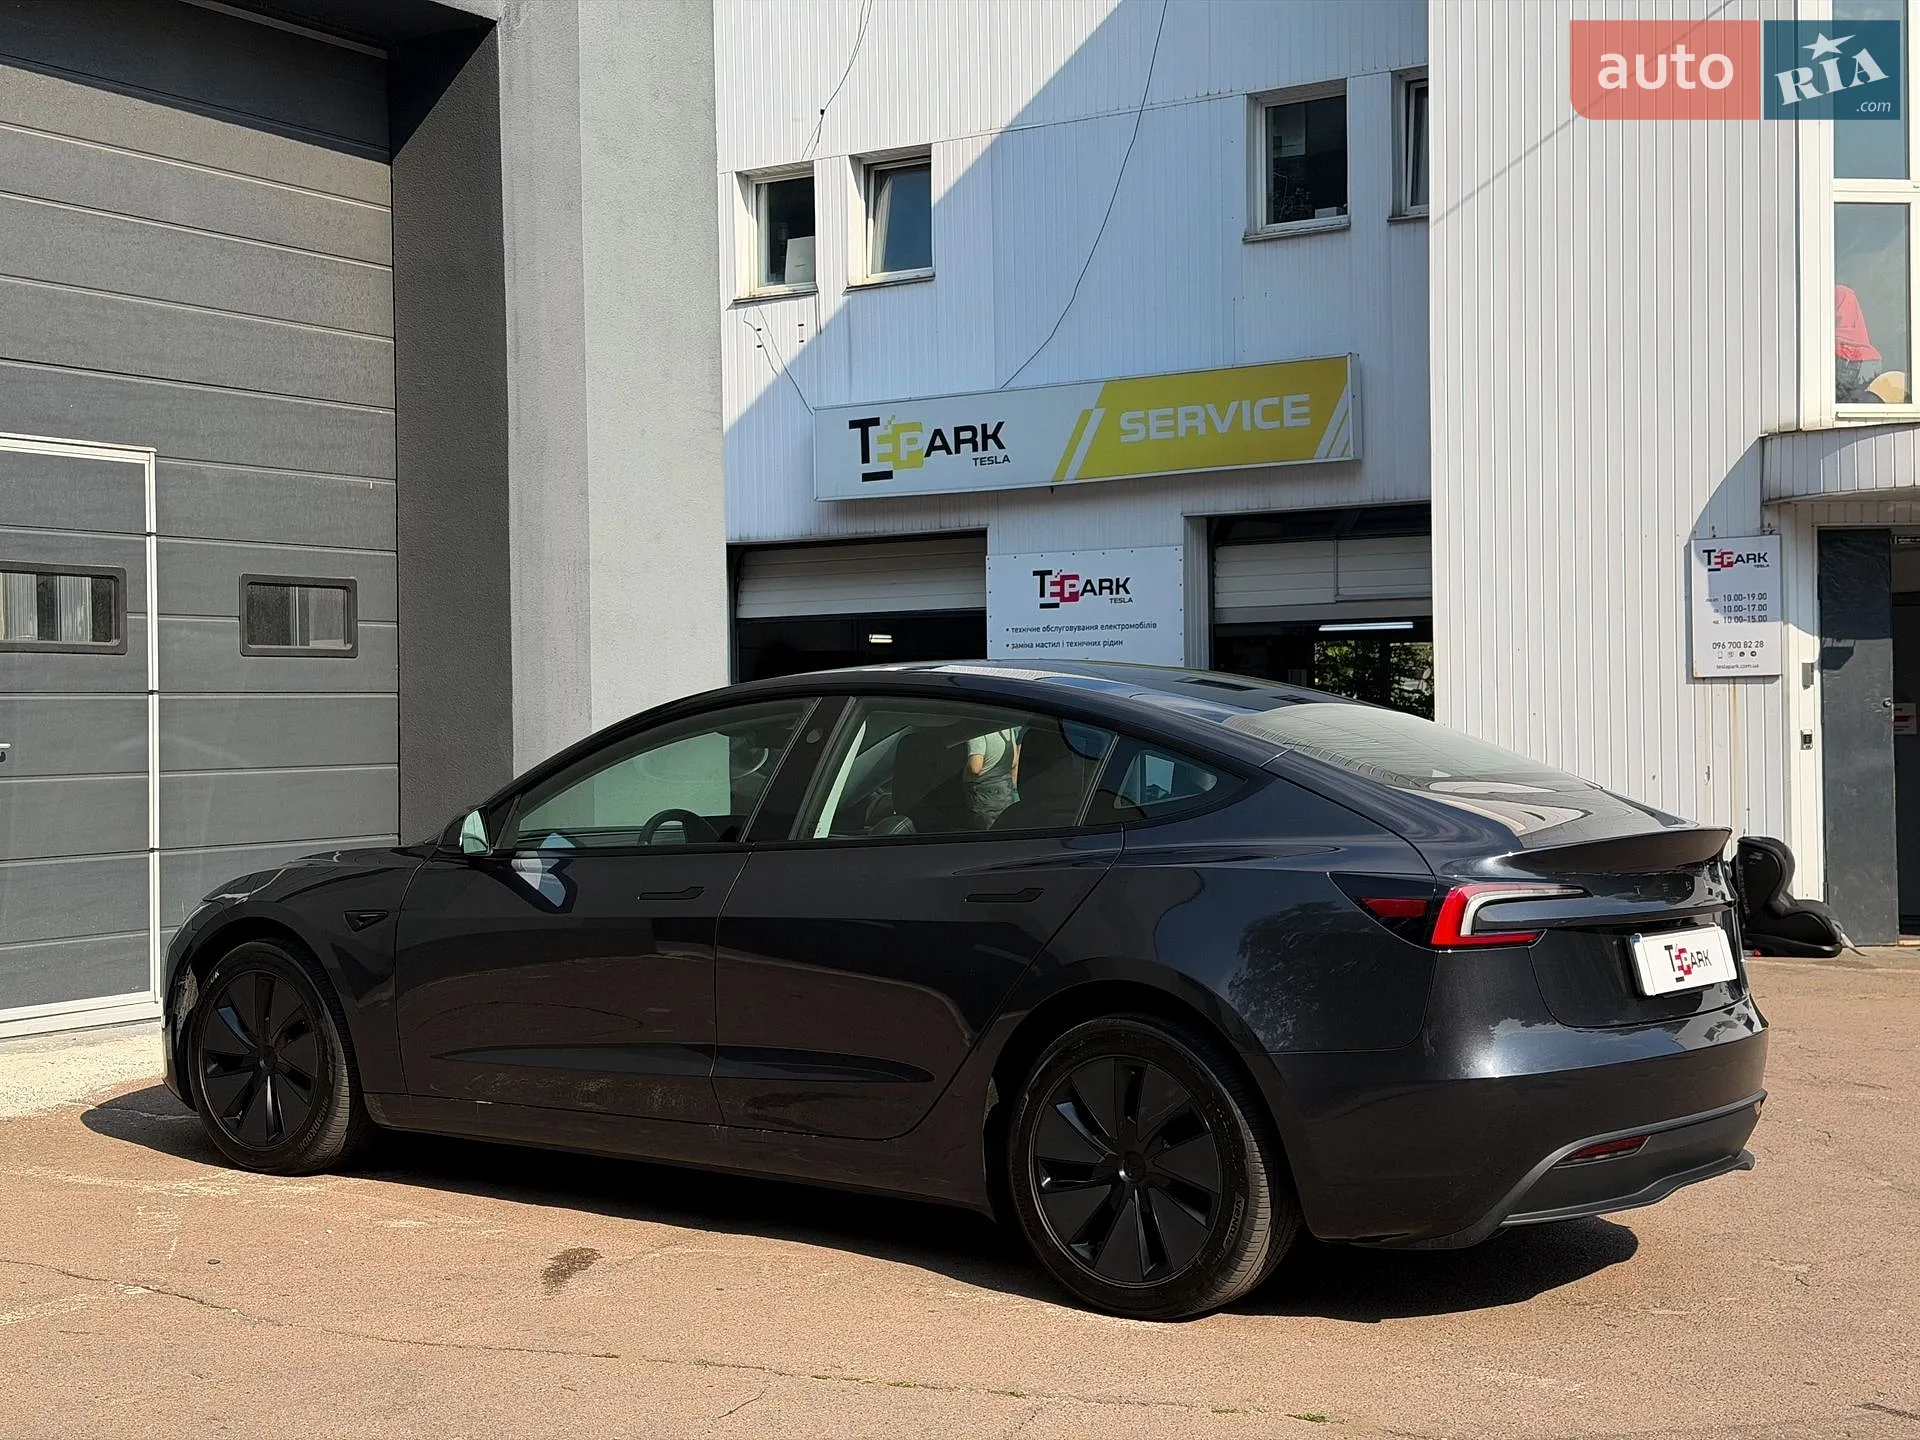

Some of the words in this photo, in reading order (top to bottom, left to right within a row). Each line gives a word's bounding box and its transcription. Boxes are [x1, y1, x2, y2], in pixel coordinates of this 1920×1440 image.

[1120, 393, 1311, 444] SERVICE
[972, 455, 1010, 467] TESLA
[1100, 621, 1158, 632] електромобілів
[1712, 642, 1726, 650] 096
[1728, 641, 1742, 649] 700
[1754, 640, 1765, 649] 28
